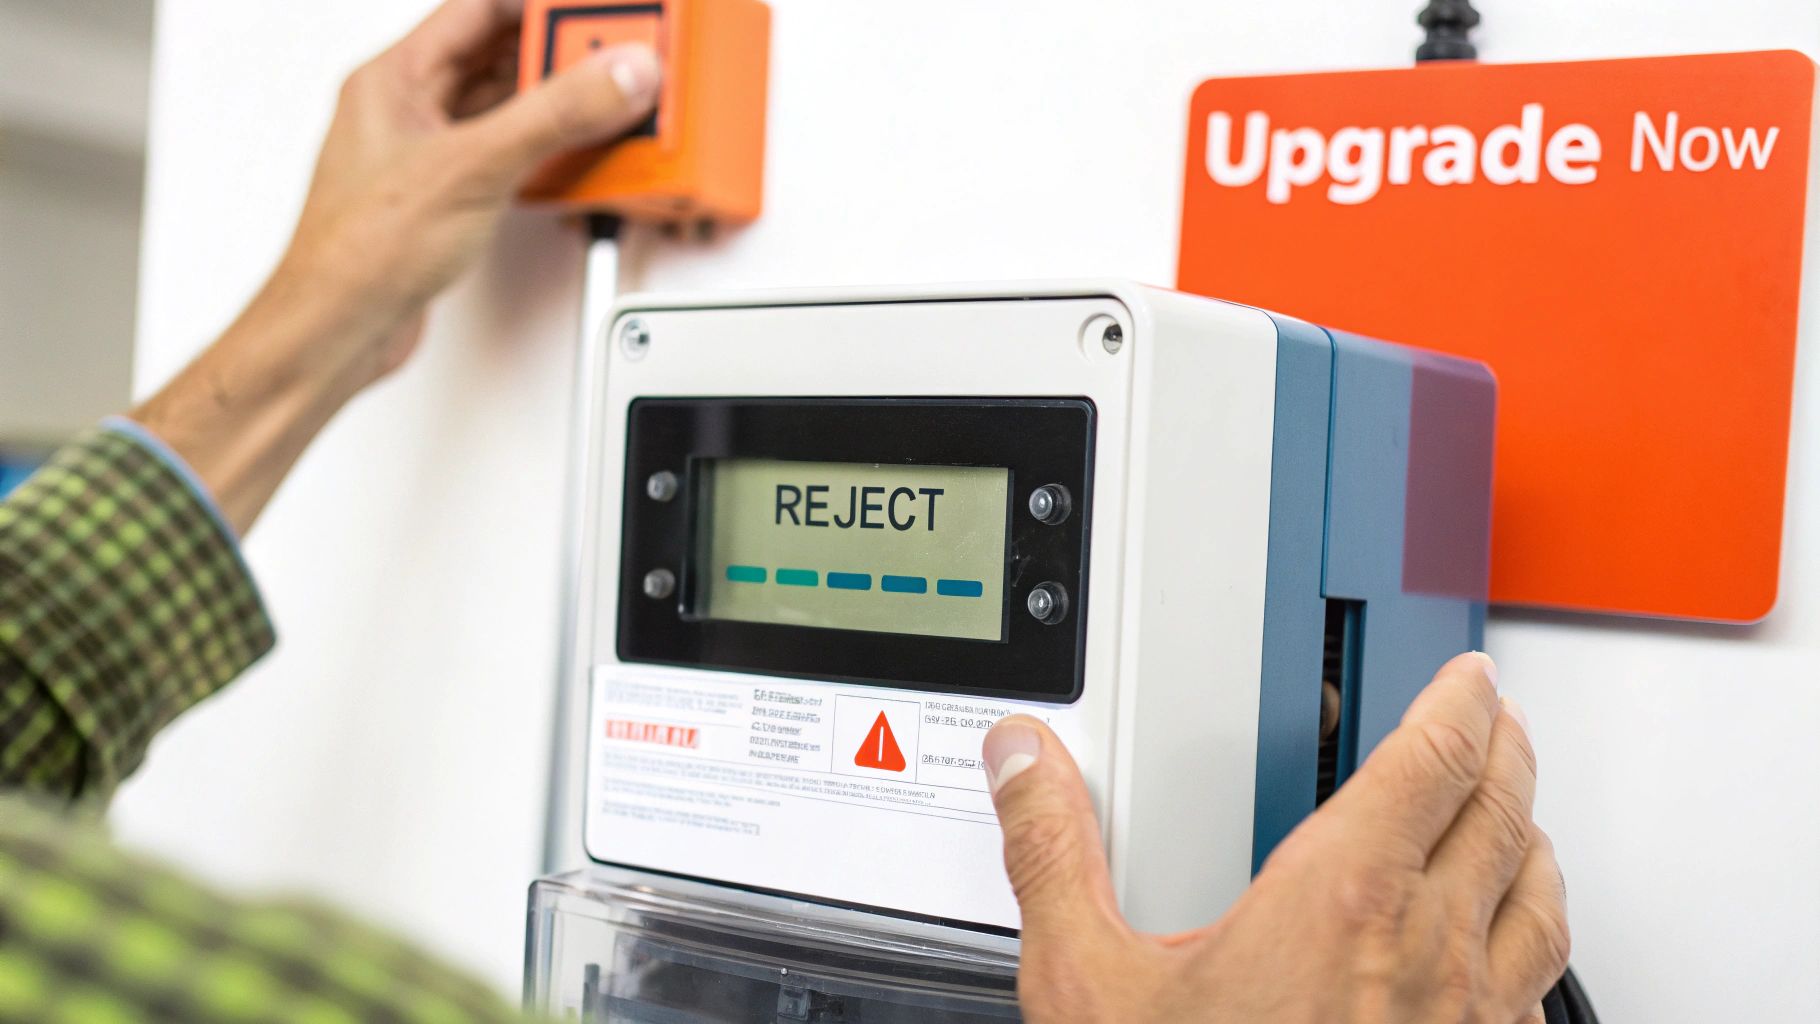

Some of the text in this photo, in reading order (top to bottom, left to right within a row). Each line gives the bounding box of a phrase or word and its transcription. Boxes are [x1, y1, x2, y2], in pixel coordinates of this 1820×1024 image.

[1205, 103, 1780, 205] Upgrade Now
[775, 484, 945, 532] REJECT
